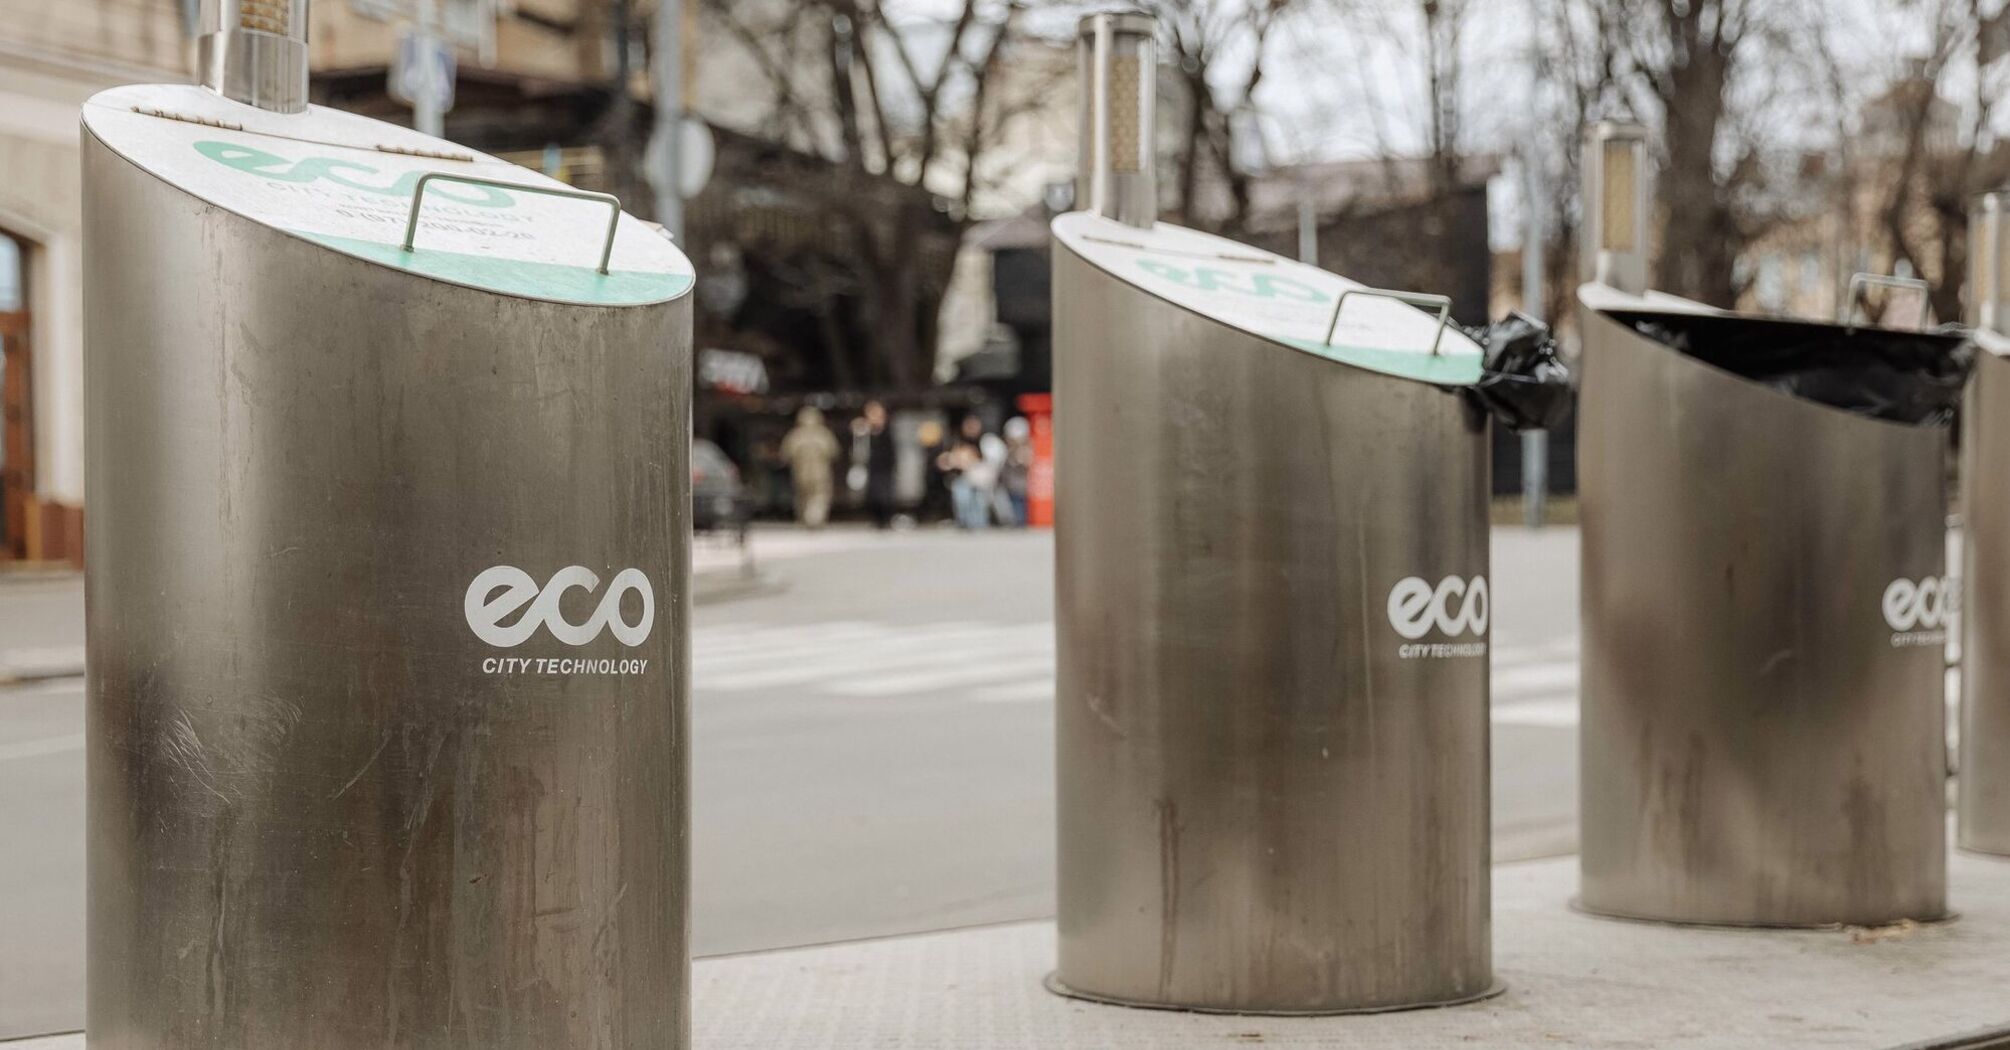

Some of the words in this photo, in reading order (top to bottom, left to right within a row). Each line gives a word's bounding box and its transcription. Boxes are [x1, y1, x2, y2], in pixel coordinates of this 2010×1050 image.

[193, 140, 516, 208] eco
[266, 181, 331, 198] CITY
[1135, 258, 1332, 304] eco
[464, 565, 655, 648] eco
[1387, 574, 1489, 640] eco
[482, 657, 532, 674] CITY
[535, 658, 648, 675] TECHNOLOGY
[1398, 643, 1431, 659] CITY
